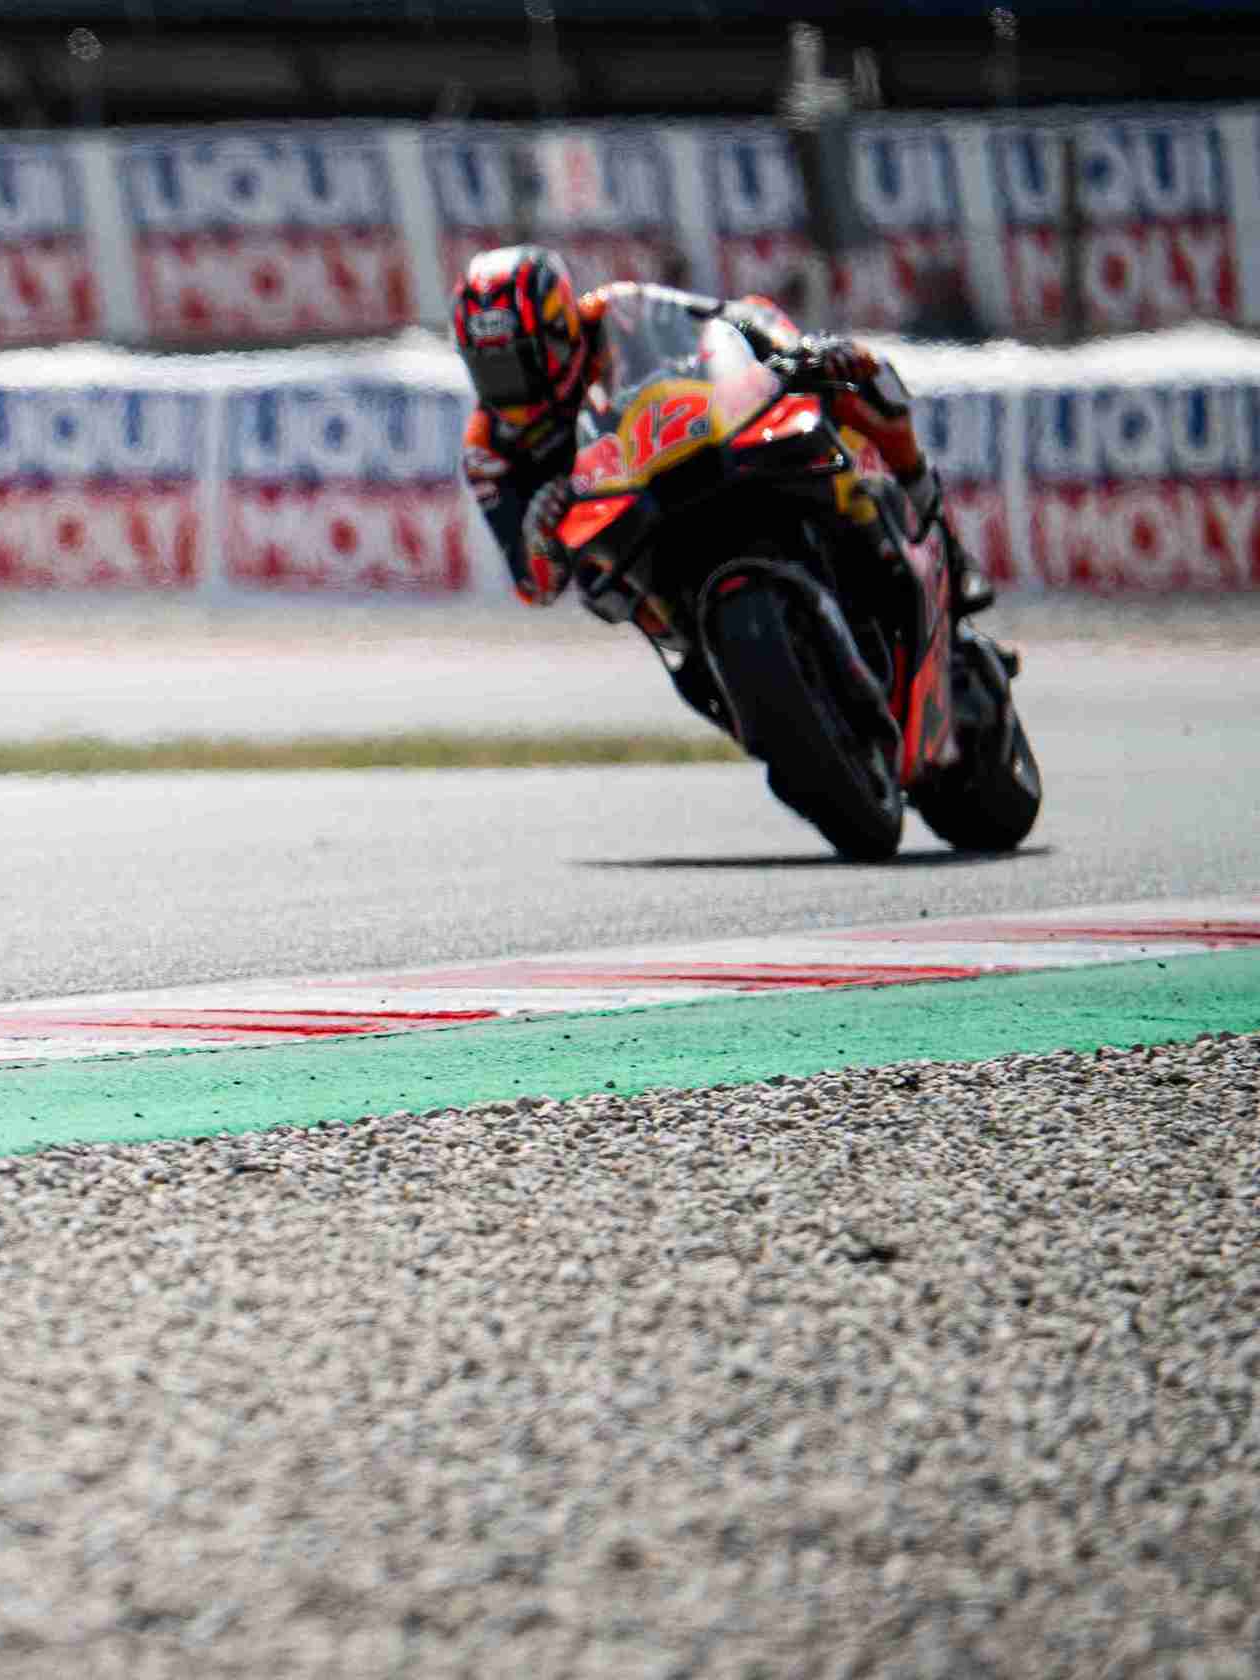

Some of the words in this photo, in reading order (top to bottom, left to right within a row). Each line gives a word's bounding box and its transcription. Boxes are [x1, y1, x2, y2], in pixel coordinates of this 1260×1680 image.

[140, 142, 380, 226] LIQUI
[150, 240, 388, 325] MOLY
[232, 399, 445, 471] LIQUI
[630, 393, 710, 475] 12
[1040, 392, 1242, 474] LIQUI
[238, 493, 455, 580] MOLY
[1044, 490, 1260, 580] MOLY
